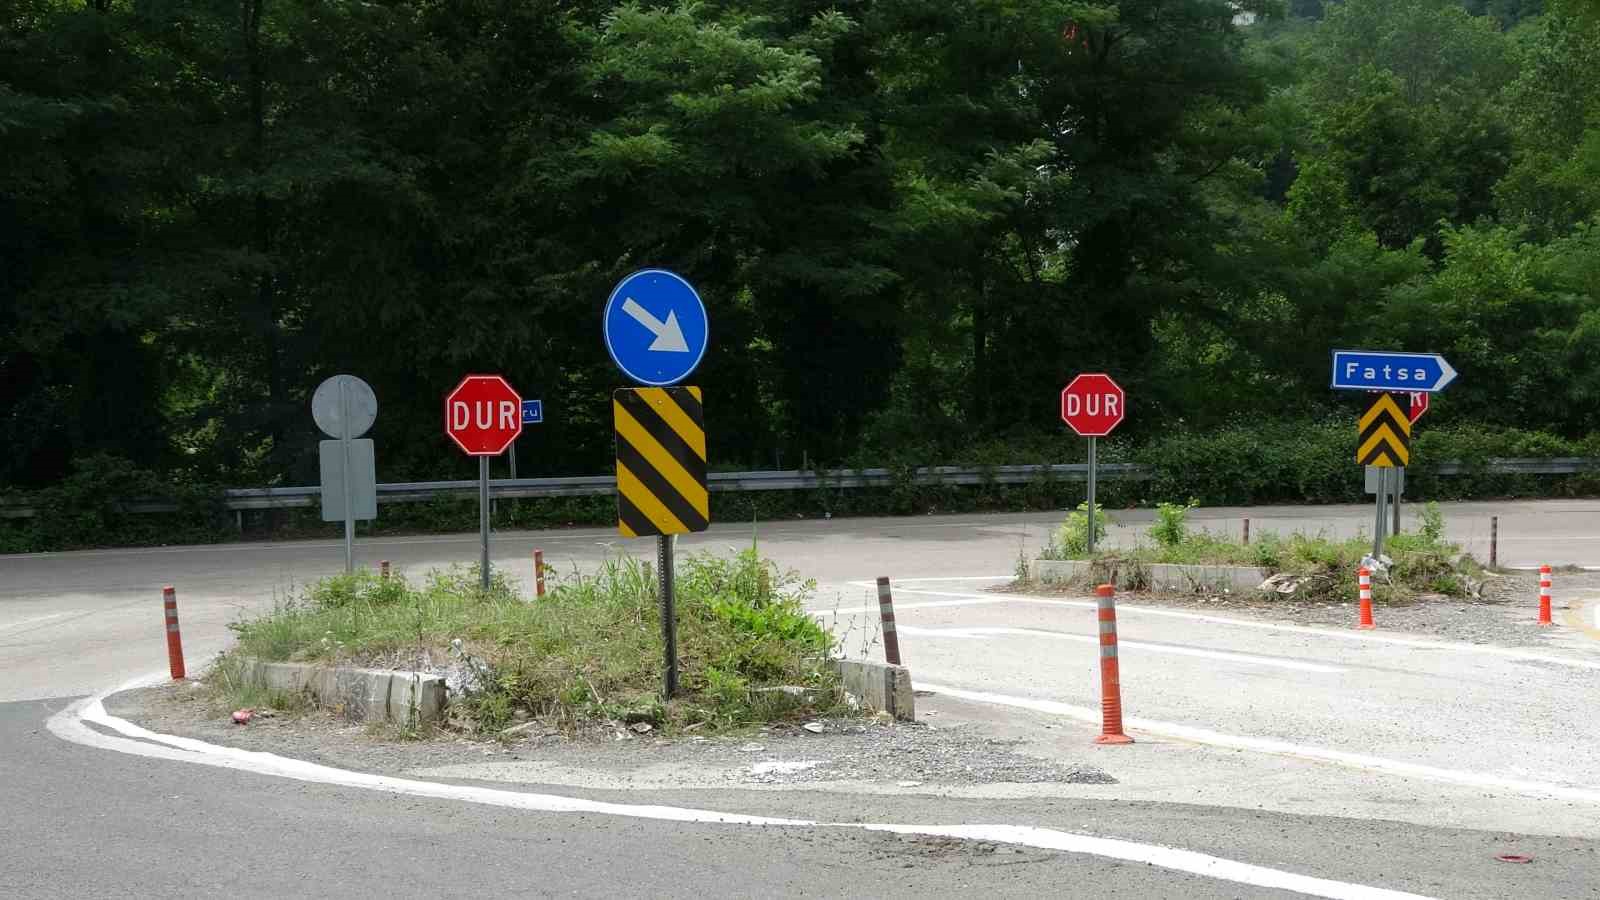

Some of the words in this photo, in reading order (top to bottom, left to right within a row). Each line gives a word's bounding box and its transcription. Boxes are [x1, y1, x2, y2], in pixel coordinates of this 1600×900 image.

[1346, 362, 1426, 381] Fatsa
[453, 400, 516, 431] DUR
[1067, 393, 1118, 417] DUR
